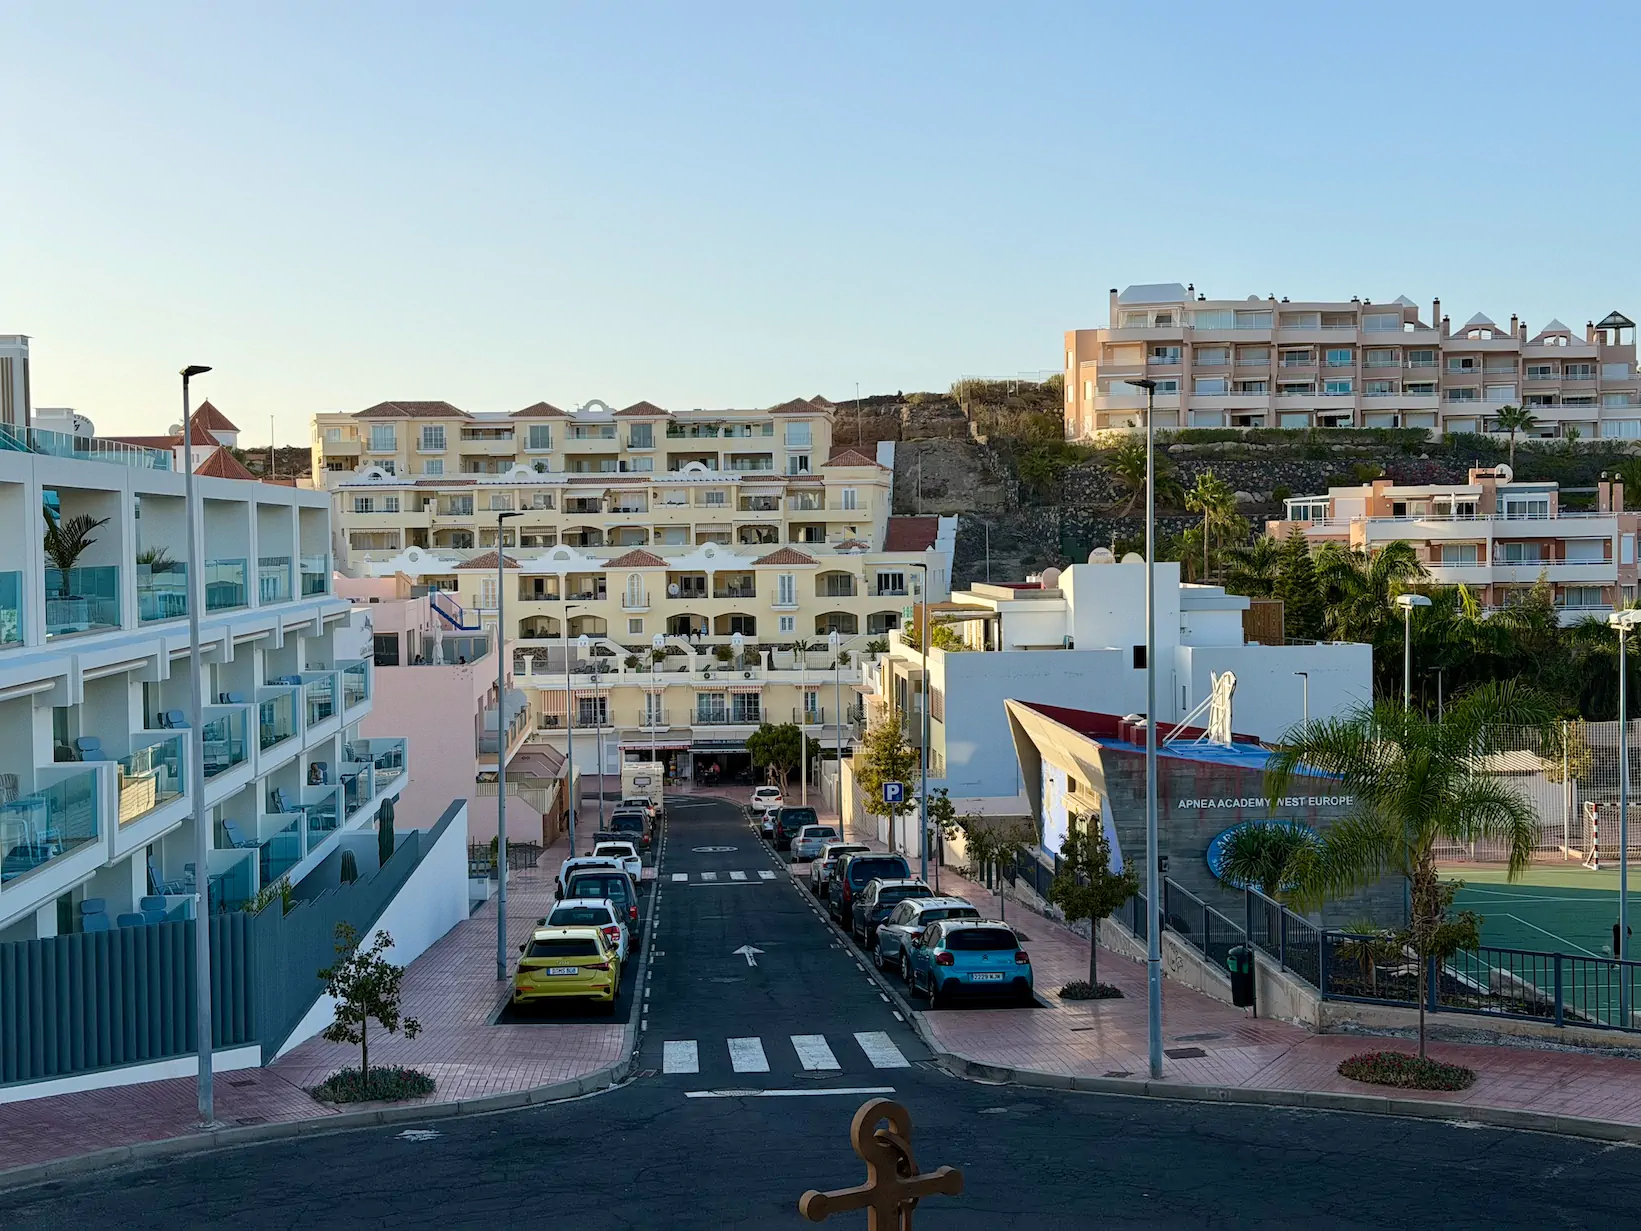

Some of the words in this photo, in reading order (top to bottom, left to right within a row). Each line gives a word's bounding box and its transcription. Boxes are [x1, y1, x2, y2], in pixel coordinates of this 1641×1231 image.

[886, 784, 900, 801] P
[1178, 799, 1216, 809] APNEA
[1217, 798, 1271, 808] ACADEMY
[1308, 796, 1353, 806] EUROPE
